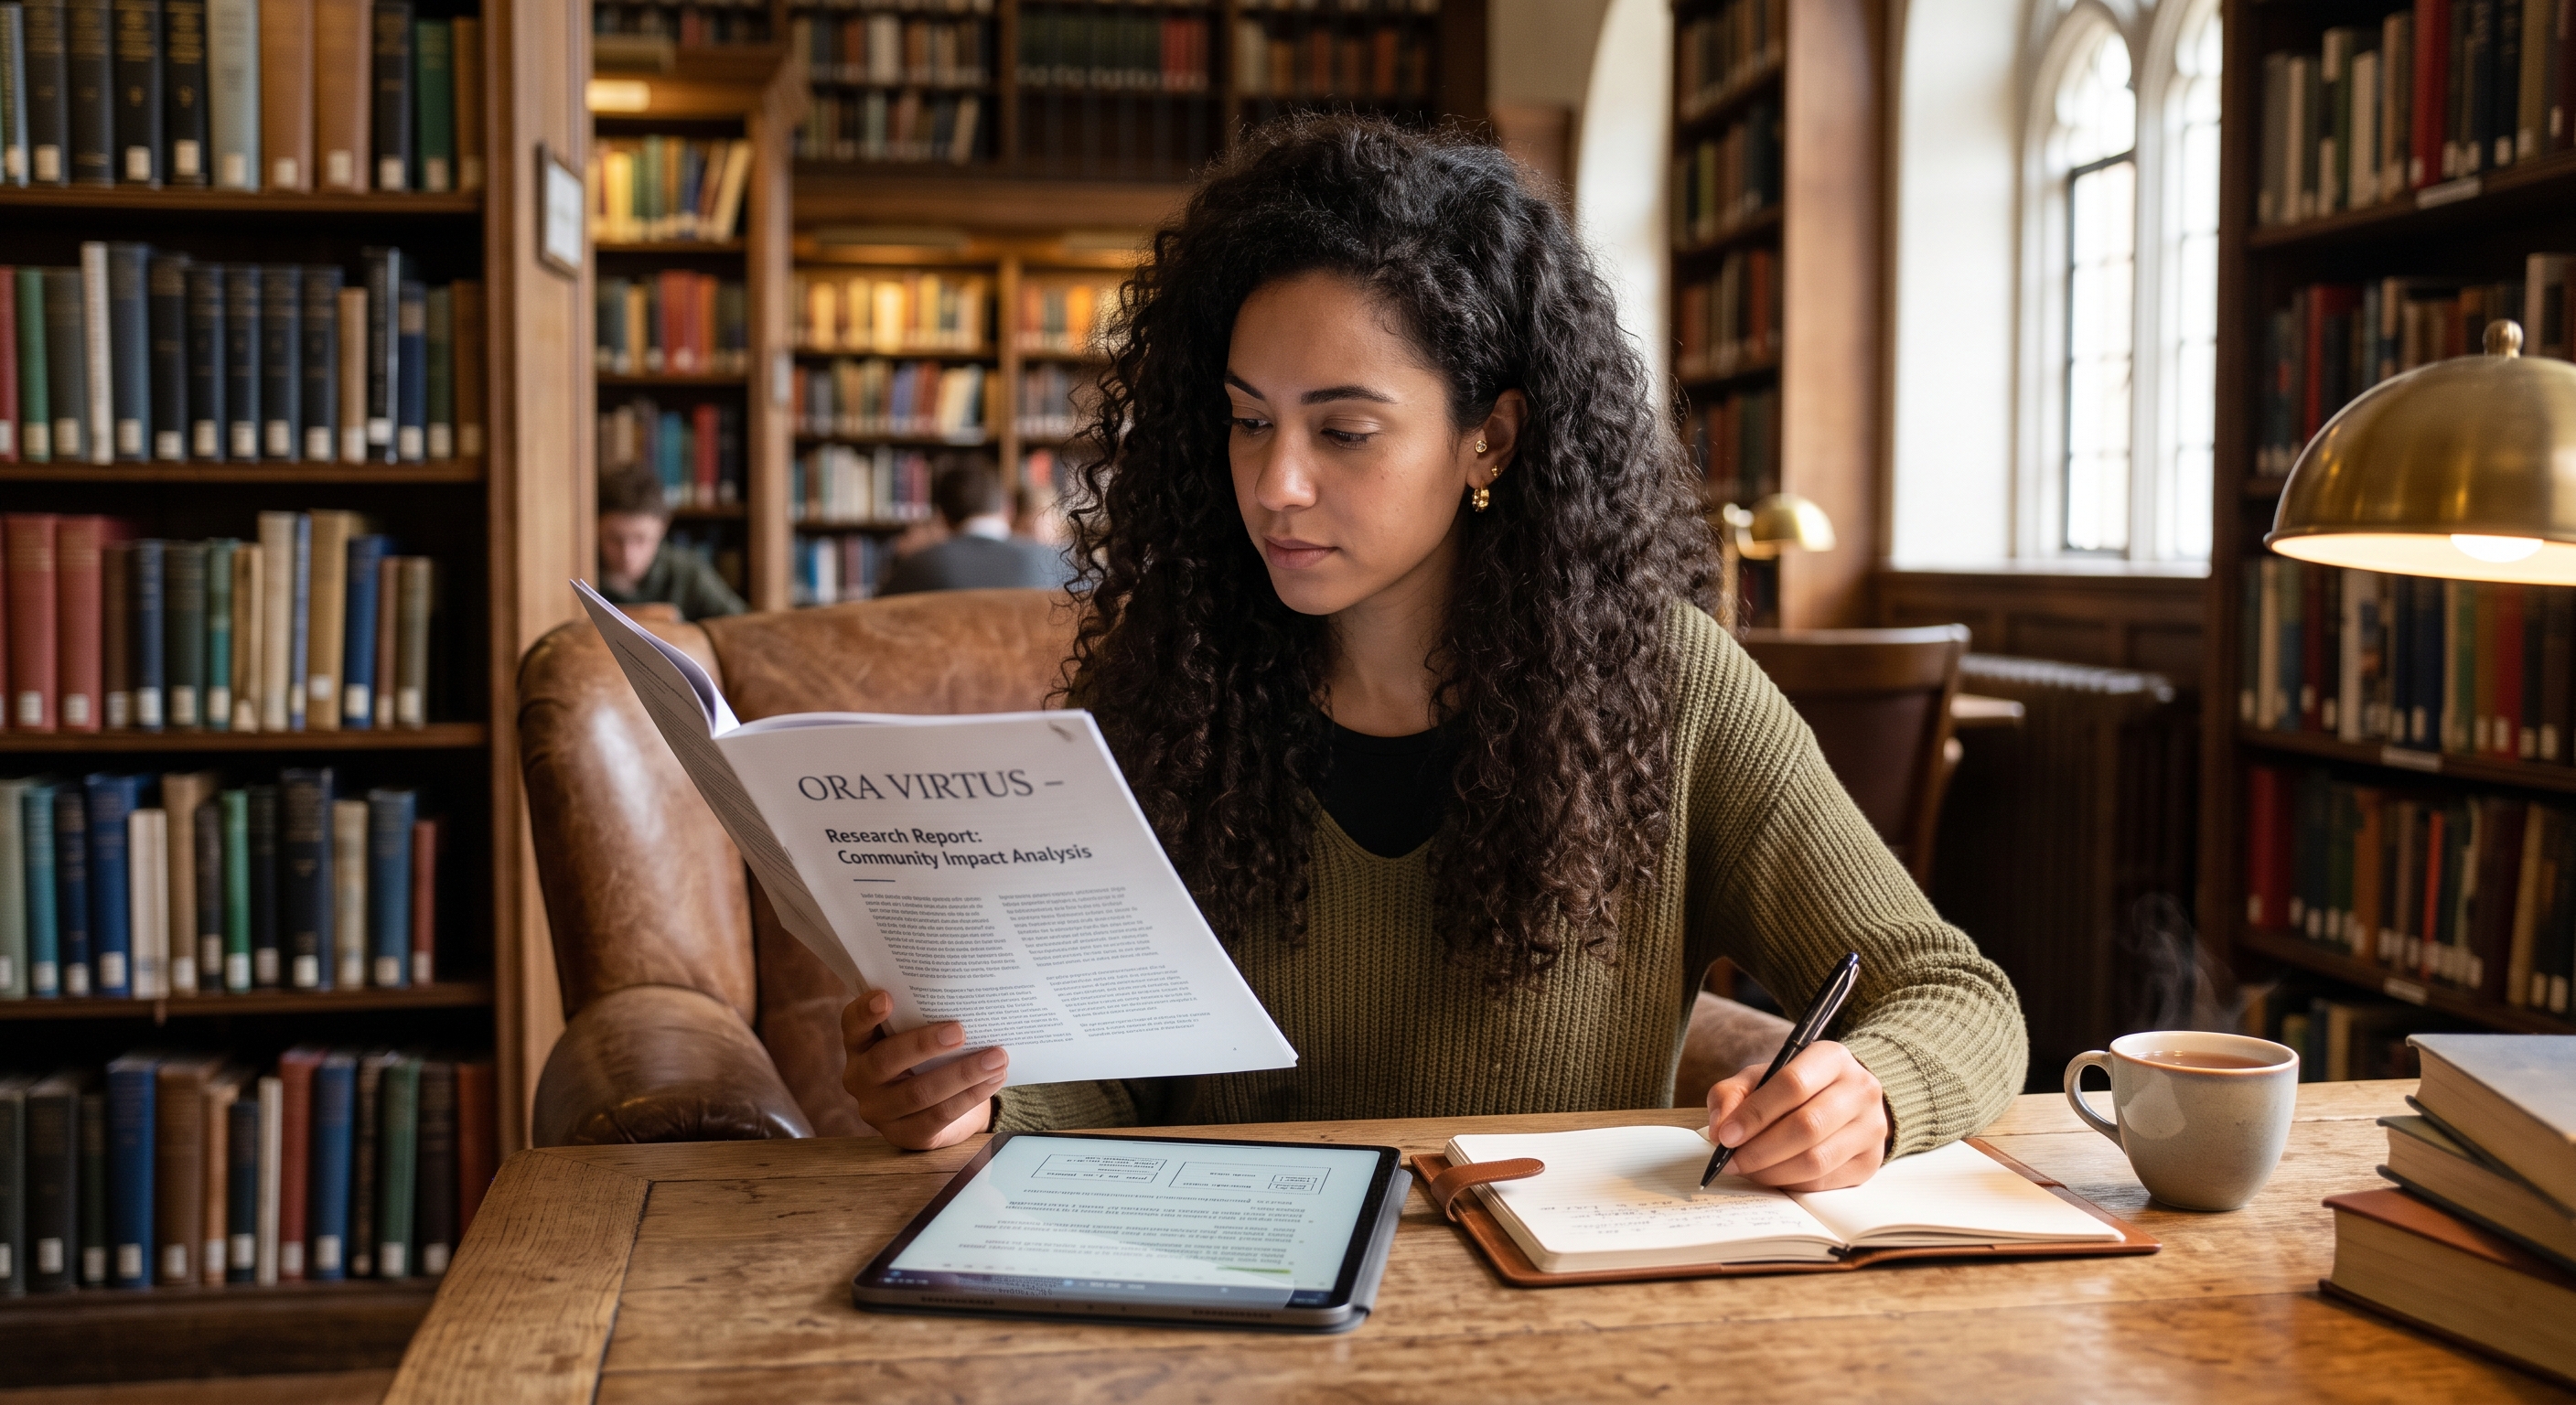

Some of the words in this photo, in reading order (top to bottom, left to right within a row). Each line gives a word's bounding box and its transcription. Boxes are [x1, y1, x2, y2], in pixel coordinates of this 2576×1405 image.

[798, 775, 886, 800] ORA
[885, 769, 1034, 799] VIRTUS
[825, 829, 908, 843] Research
[911, 829, 982, 847] Report:
[838, 851, 938, 869] Community
[942, 852, 1008, 868] Impact
[1013, 844, 1092, 863] Analysis
